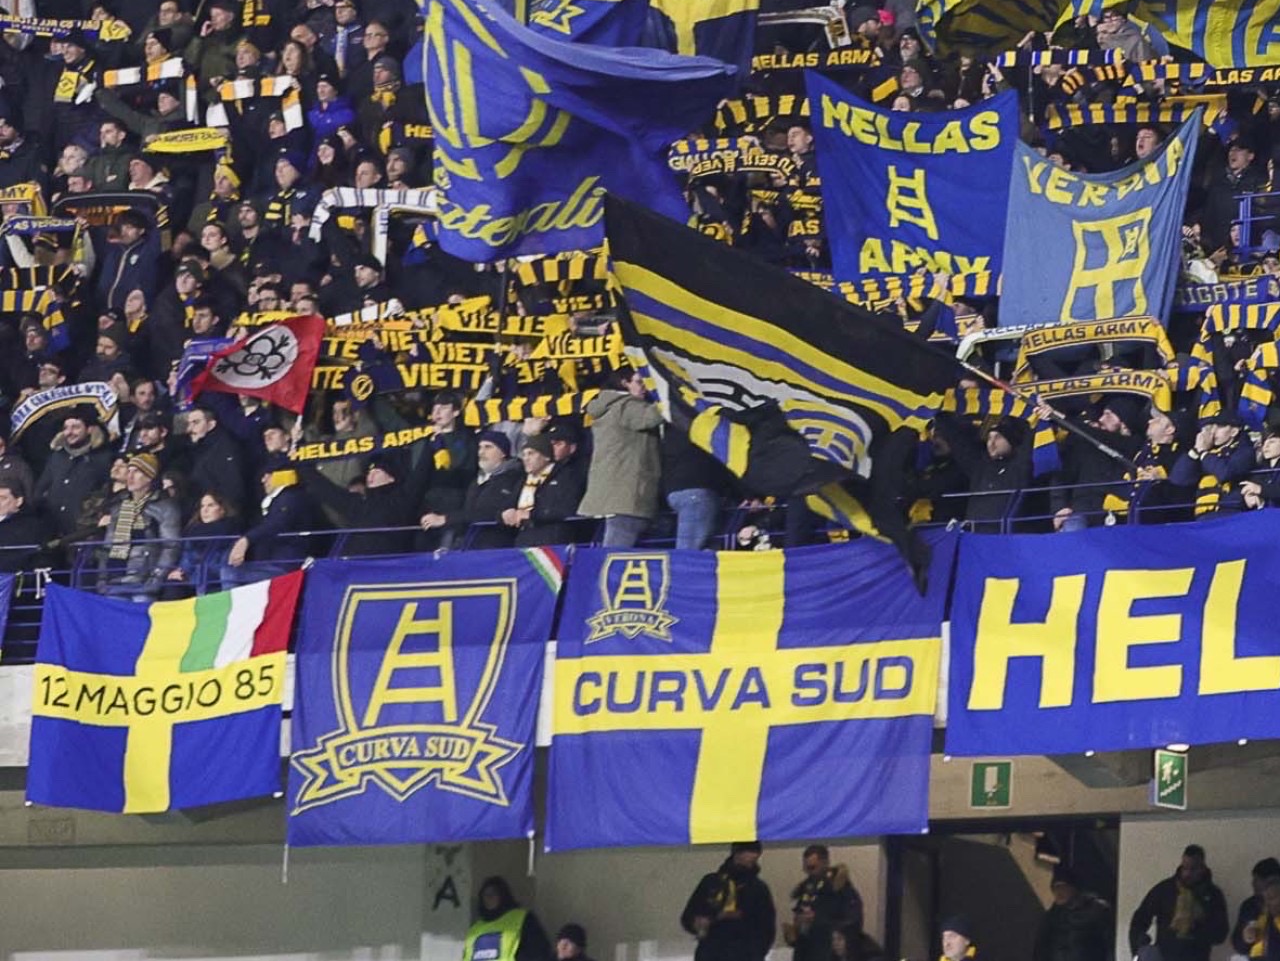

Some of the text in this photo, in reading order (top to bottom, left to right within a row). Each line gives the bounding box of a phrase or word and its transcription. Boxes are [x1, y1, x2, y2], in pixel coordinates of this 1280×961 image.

[822, 93, 1000, 155] HELLAS
[1093, 320, 1150, 342] ARMY
[40, 664, 276, 717] 12 MAGGIO 85
[572, 656, 916, 716] CURVA SUD
[340, 736, 470, 766] CURVA SUD
